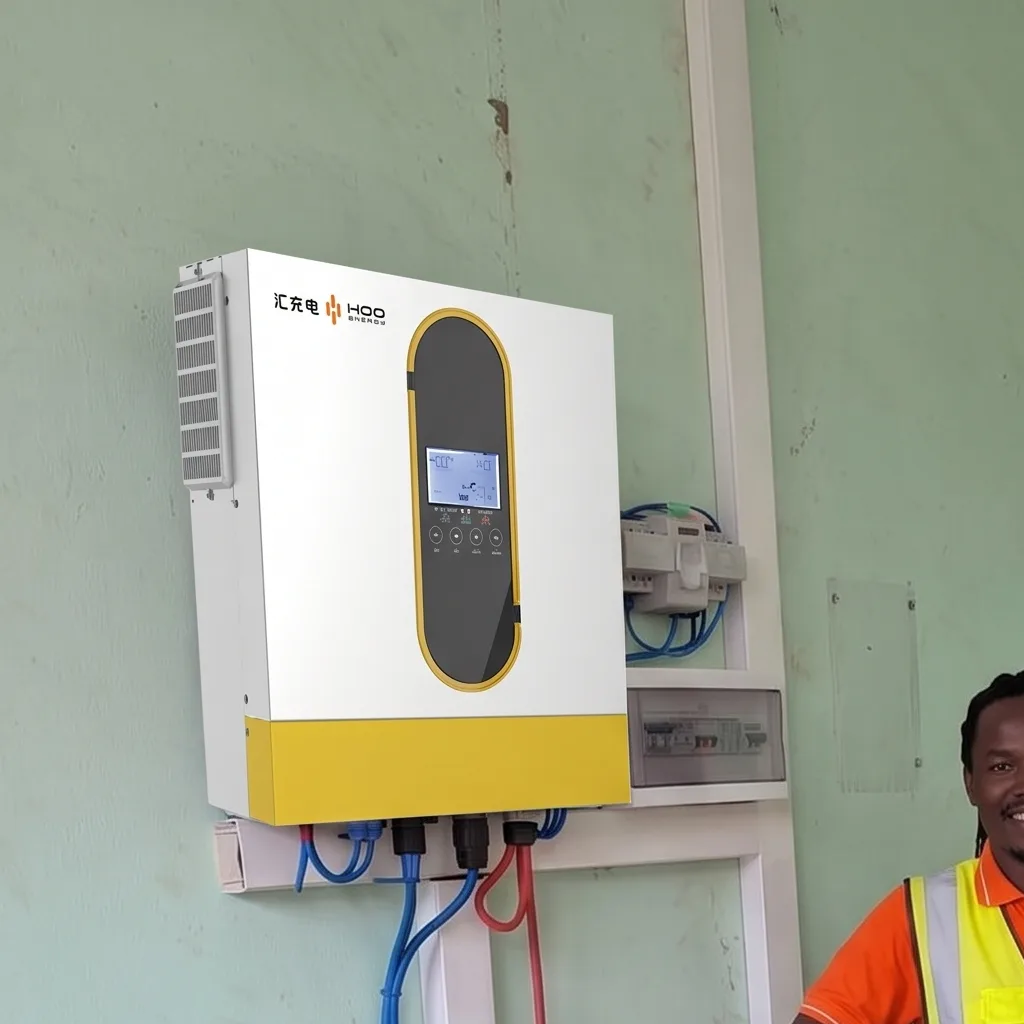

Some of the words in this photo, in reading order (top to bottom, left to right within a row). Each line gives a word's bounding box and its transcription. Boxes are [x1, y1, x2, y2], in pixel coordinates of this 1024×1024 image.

[274, 292, 319, 315] 汇充电
[347, 303, 385, 318] HOO
